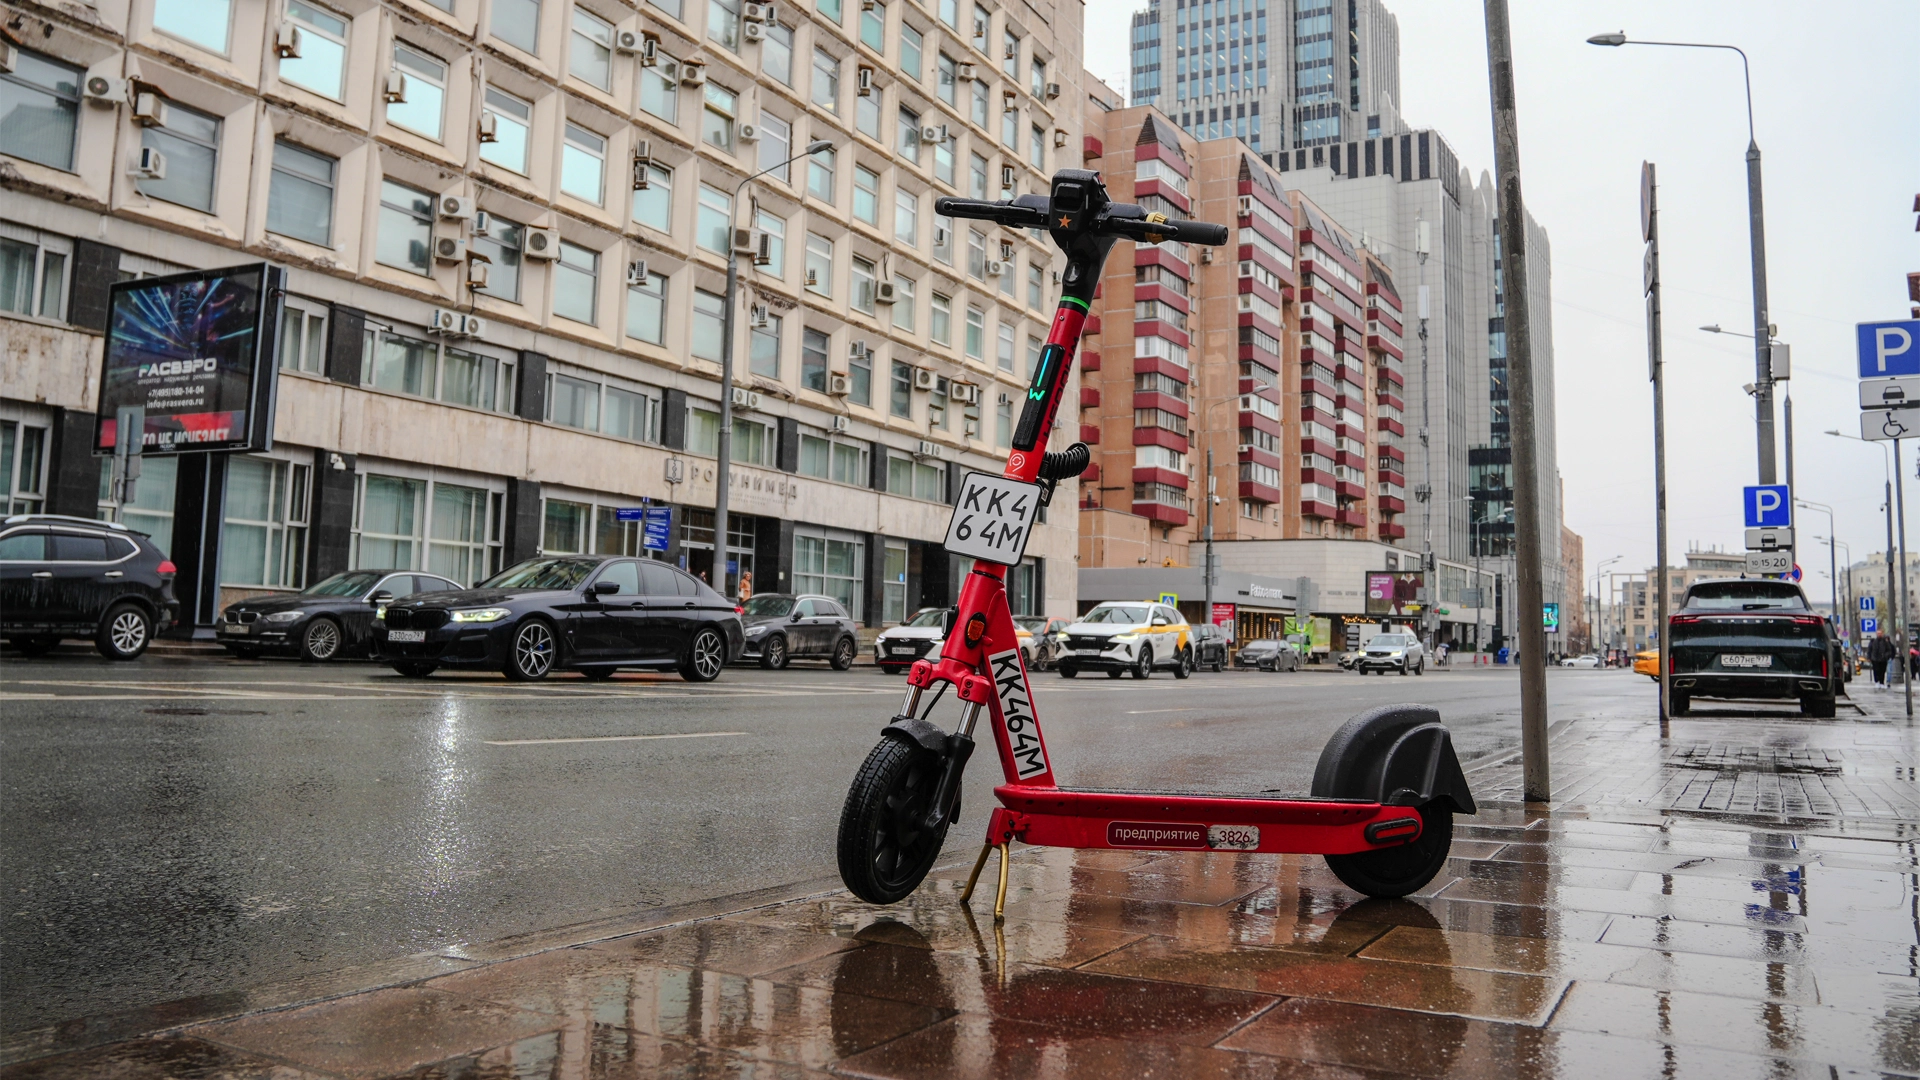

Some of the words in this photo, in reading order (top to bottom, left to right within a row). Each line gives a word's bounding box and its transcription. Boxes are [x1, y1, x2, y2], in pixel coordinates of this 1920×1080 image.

[1875, 326, 1912, 372] P
[138, 357, 217, 378] РАСВЭРО
[690, 465, 798, 500] РОУНИМЕД
[1755, 489, 1782, 523] P
[1761, 558, 1770, 567] 15
[1773, 557, 1787, 567] 20
[1864, 619, 1874, 632] P
[1115, 828, 1200, 842] предприятие
[1219, 830, 1250, 843] 3826
